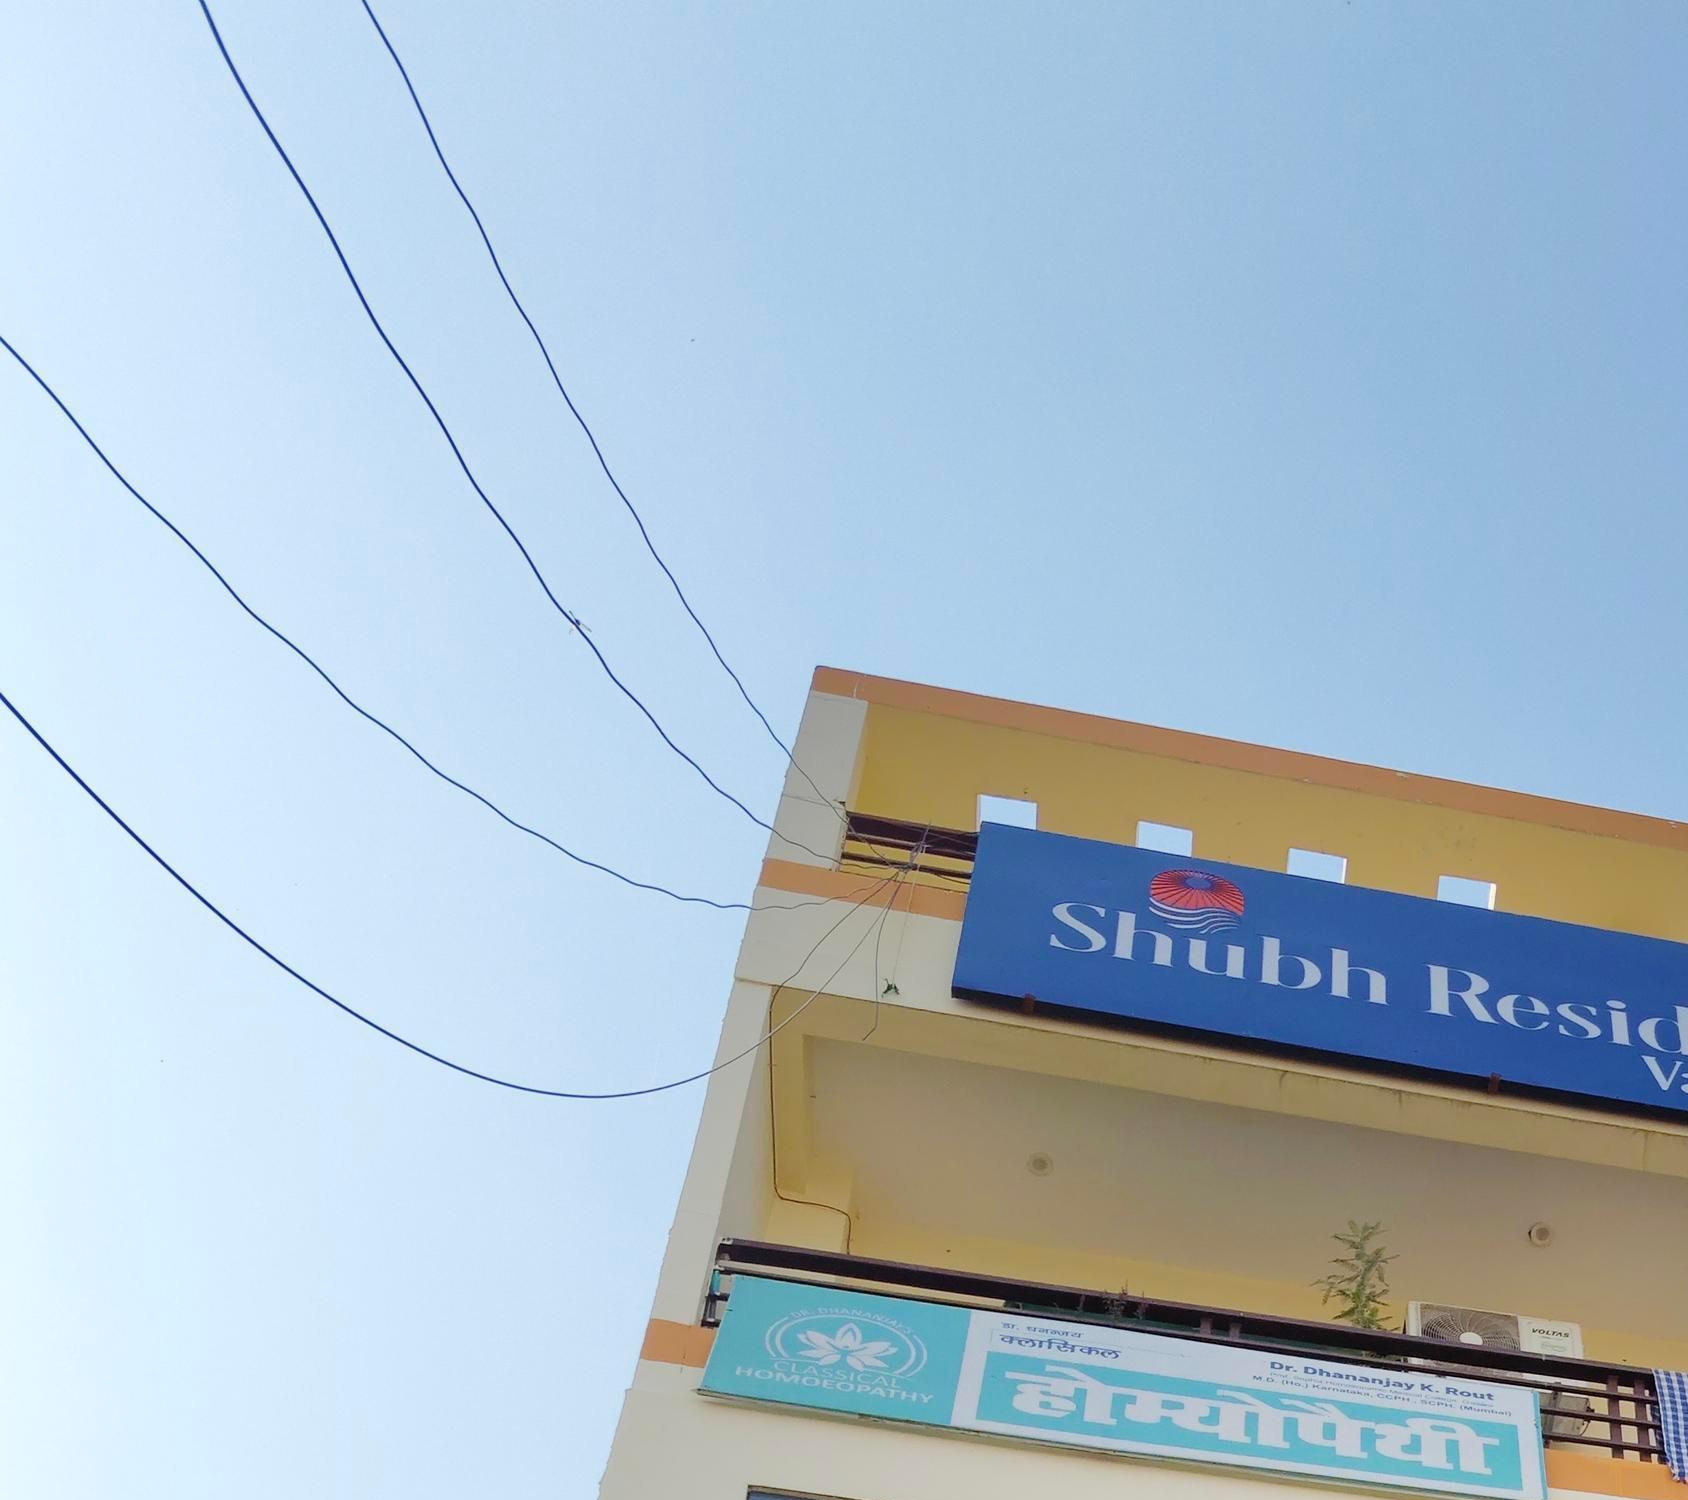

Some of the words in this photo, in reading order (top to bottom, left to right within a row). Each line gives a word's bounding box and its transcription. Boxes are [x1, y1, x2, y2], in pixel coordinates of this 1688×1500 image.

[1048, 899, 1390, 1007] Shubh
[1000, 1335, 1122, 1359] क्लासिकल
[1531, 1327, 1570, 1339] VOLTAS
[735, 1366, 934, 1404] HOMOEOPATHY
[774, 1361, 900, 1388] CLASSICAL
[1270, 1360, 1298, 1374] Dr.
[1300, 1365, 1416, 1391] Dhananjay
[1446, 1387, 1495, 1402] Rout
[1004, 1364, 1499, 1475] होम्योपैथी
